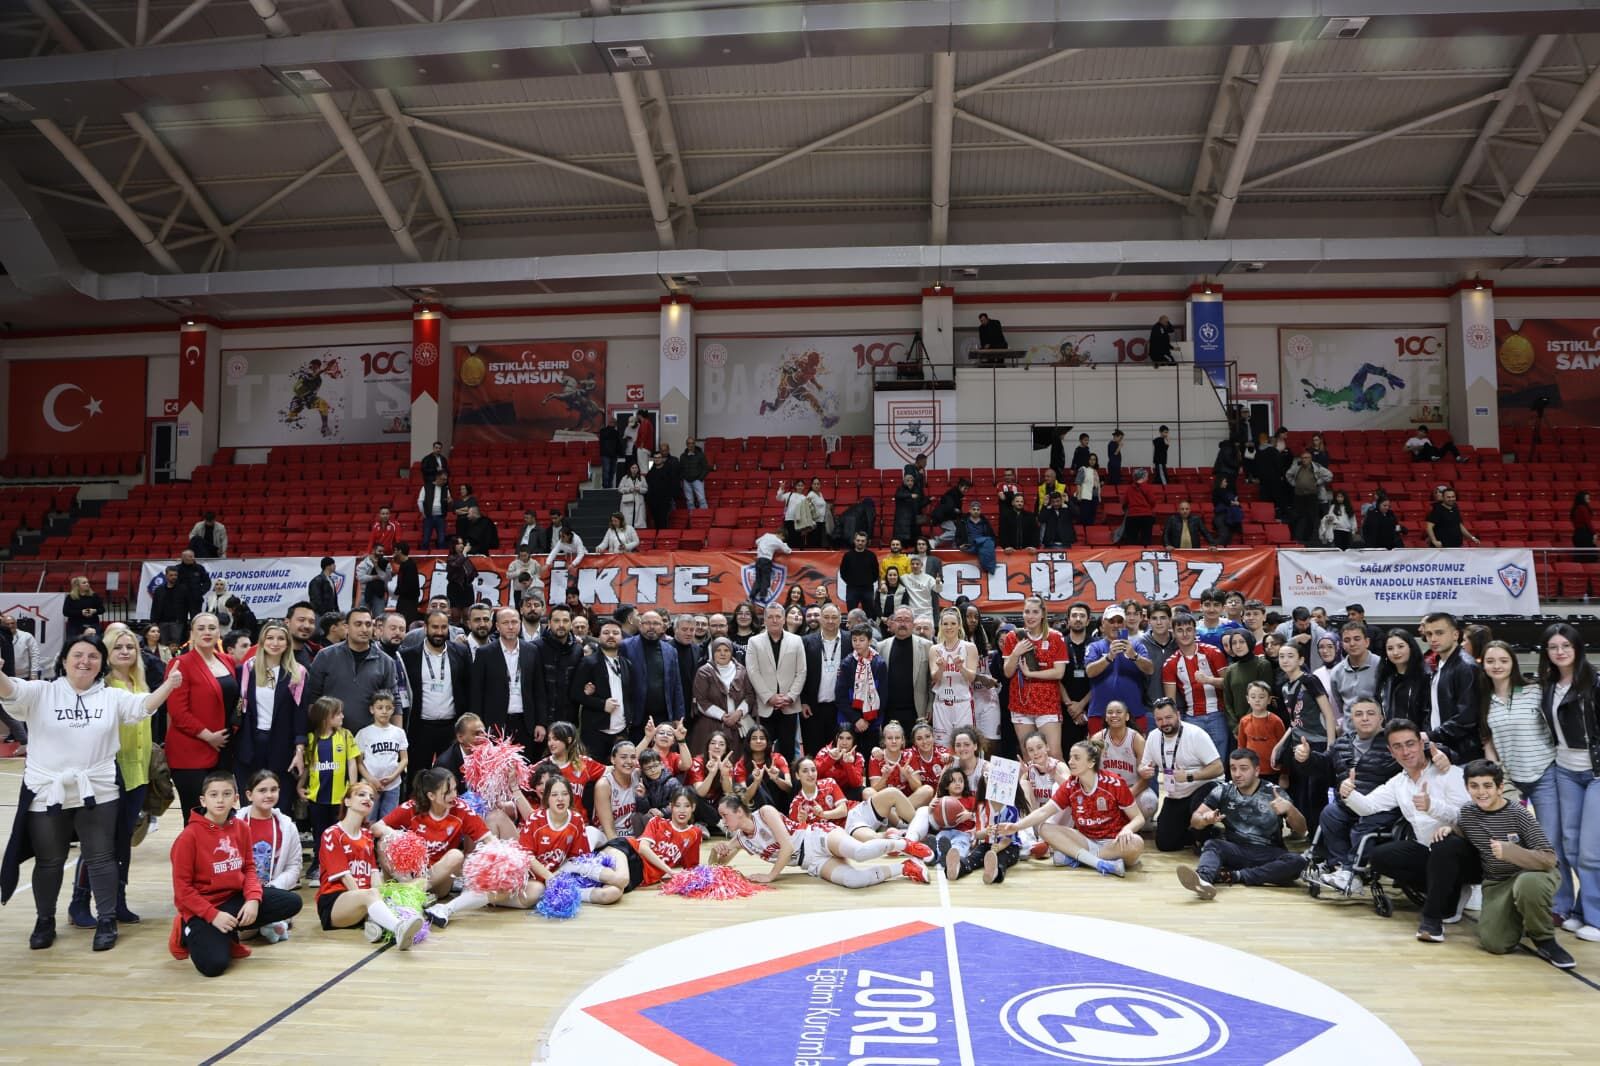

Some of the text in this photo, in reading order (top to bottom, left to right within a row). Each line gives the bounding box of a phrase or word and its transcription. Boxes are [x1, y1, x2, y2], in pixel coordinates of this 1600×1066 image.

[488, 360, 569, 372] İSTİKLAL ŞEHRİ
[494, 371, 564, 385] SAMSUN
[627, 388, 644, 399] C3
[1359, 562, 1465, 573] SAĞLIK SPONSORUMUZ
[224, 569, 291, 579] SPONSORUMUZ
[245, 581, 308, 592] KURUMLARINA
[1337, 574, 1494, 587] BÜYÜK ANADOLU HASTANELERİNE
[251, 592, 282, 604] EDERİZ
[1374, 590, 1458, 603] TEŞEKKÜR EDERİZ
[55, 708, 104, 720] ZORLU
[370, 741, 401, 754] ZORLU
[806, 968, 848, 1004] Eğitim
